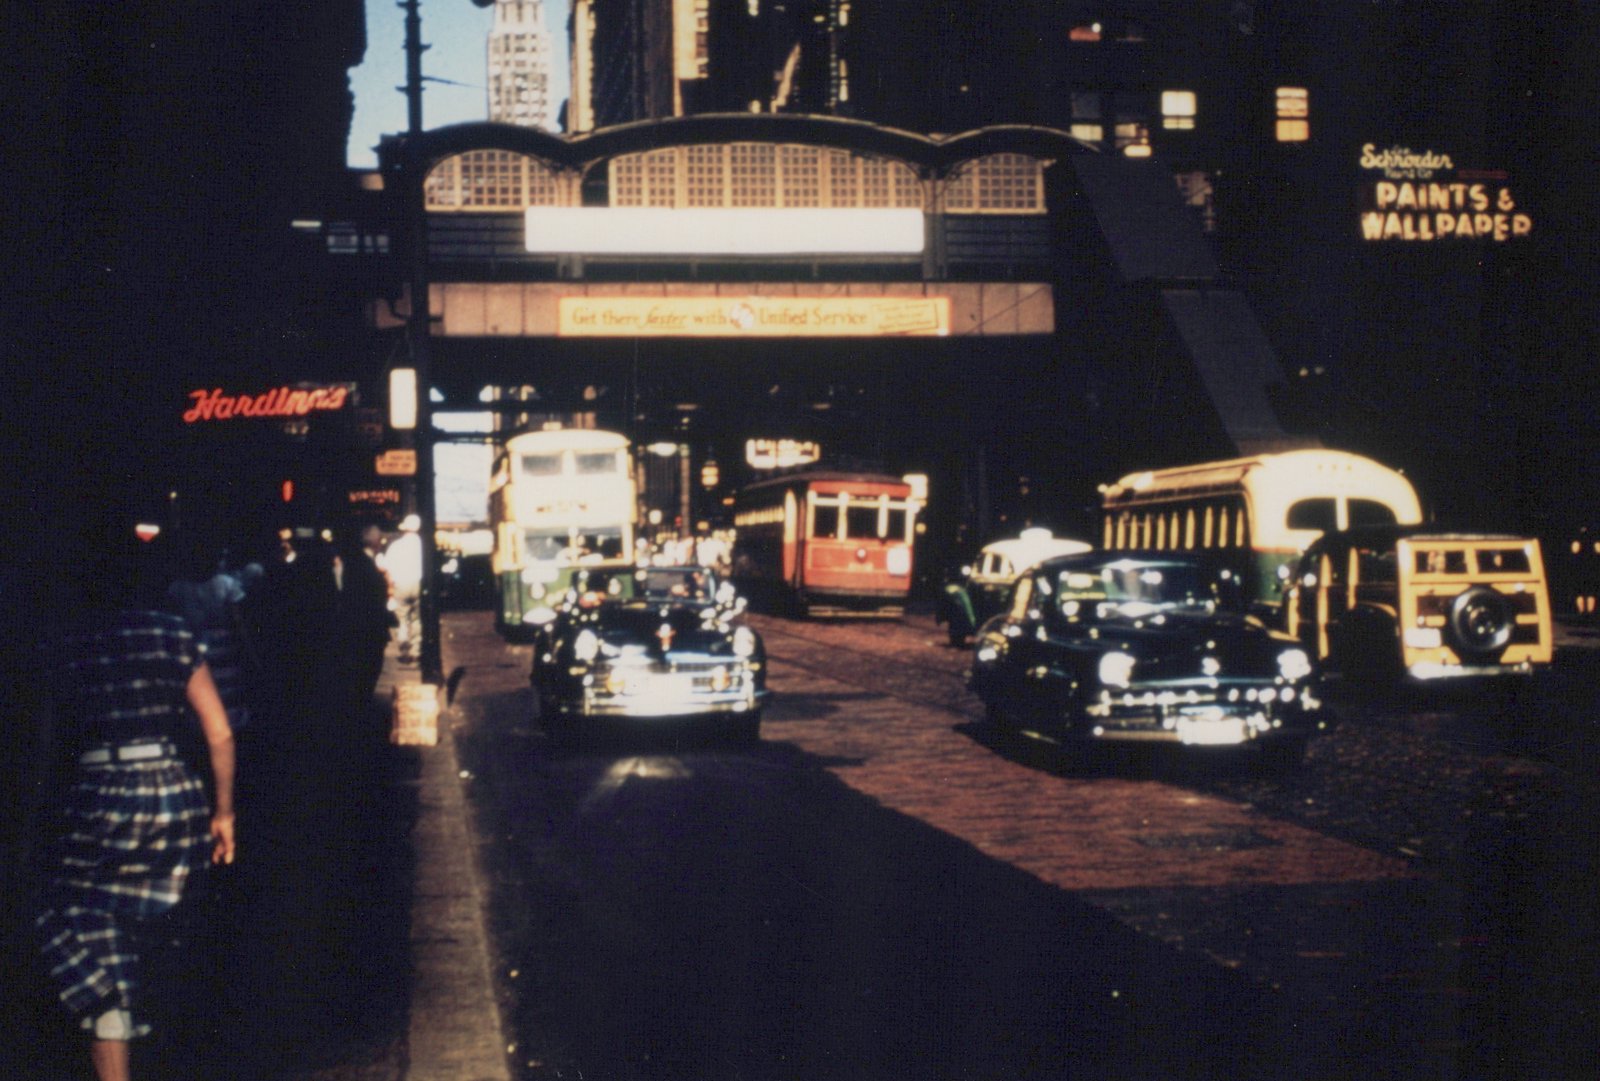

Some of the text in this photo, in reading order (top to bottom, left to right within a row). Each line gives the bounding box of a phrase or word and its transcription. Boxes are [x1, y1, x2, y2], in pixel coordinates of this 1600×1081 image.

[1376, 182, 1514, 211] PAINTS &
[572, 306, 597, 325] Get
[602, 308, 641, 325] there
[692, 308, 728, 325] with
[812, 306, 867, 325] Service
